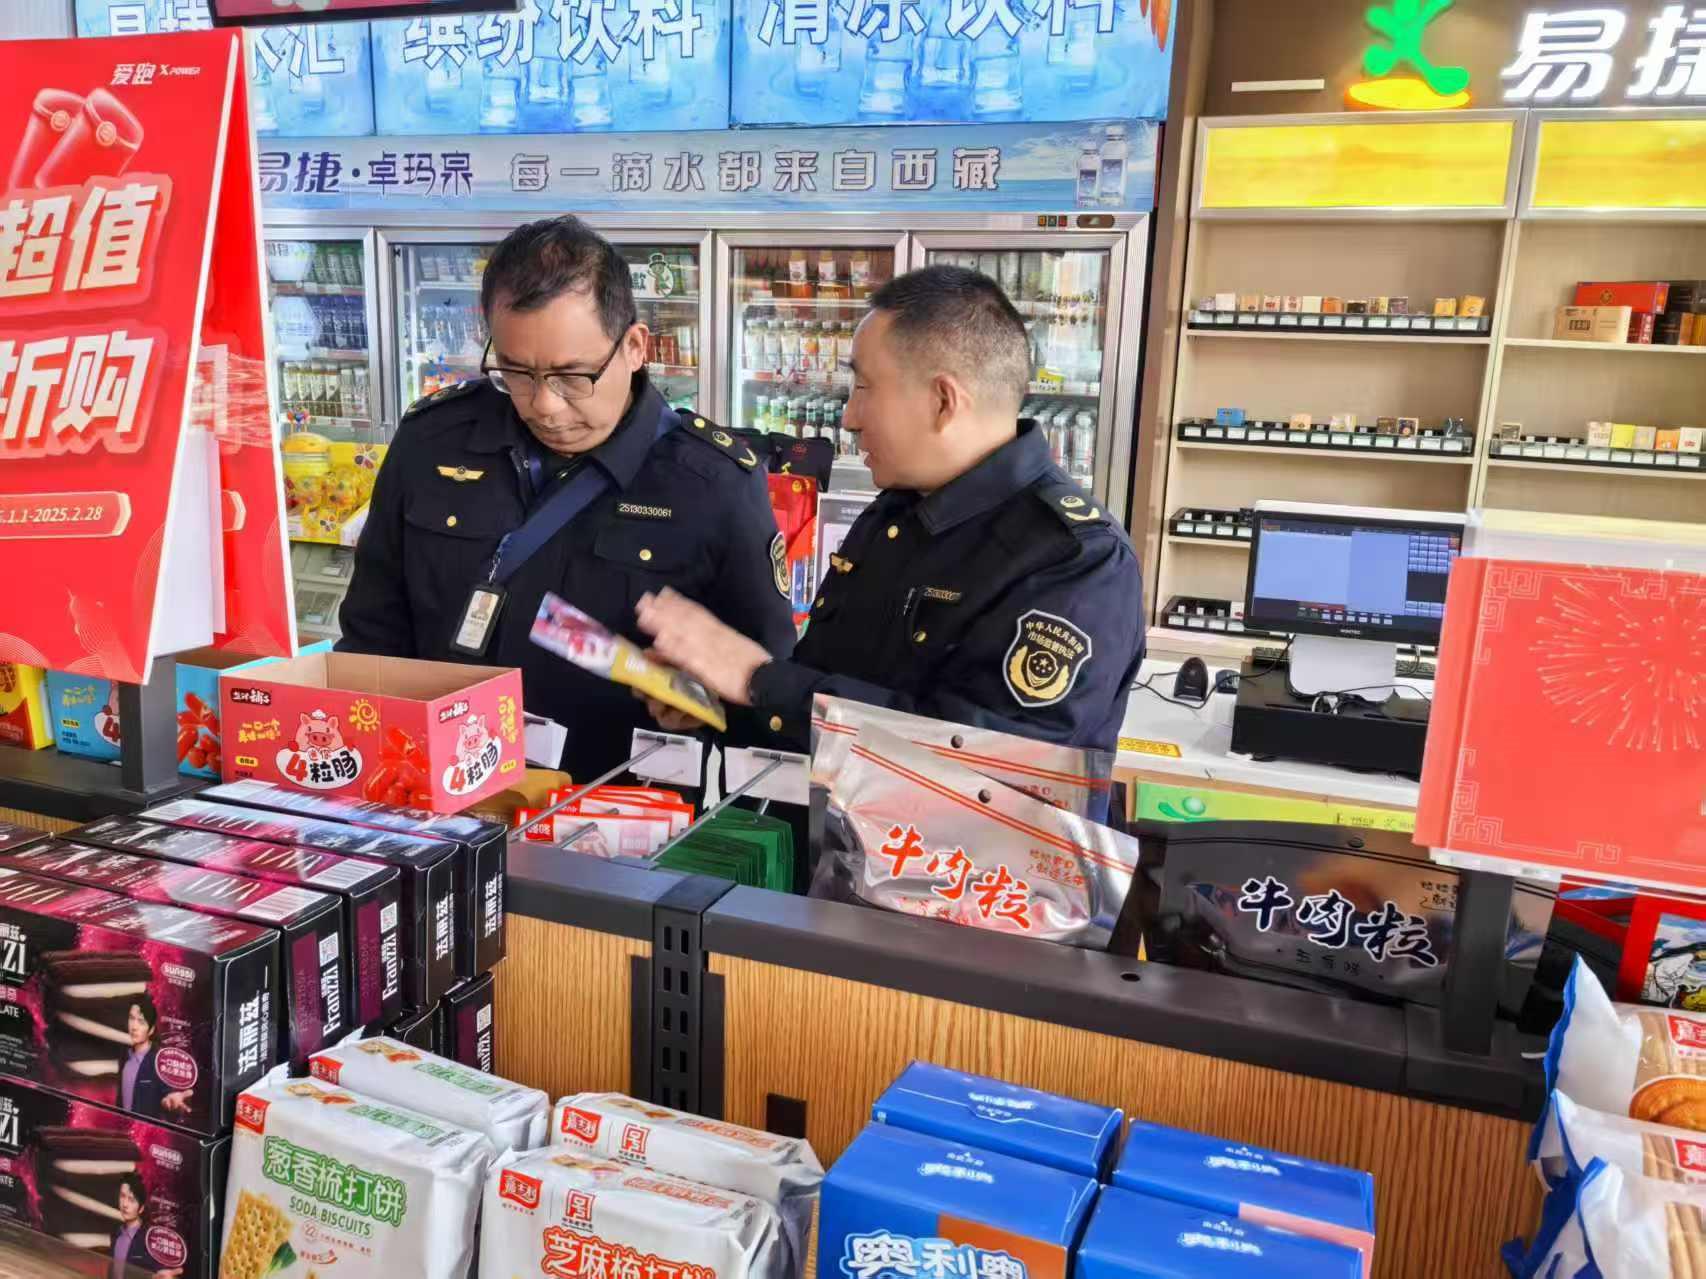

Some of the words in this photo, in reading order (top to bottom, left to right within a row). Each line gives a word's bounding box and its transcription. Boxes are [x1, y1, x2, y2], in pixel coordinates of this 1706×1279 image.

[110, 62, 157, 86] 爱跑
[511, 147, 1001, 193] 每一滴水都来自西藏
[0, 183, 159, 298] 超值
[879, 824, 1031, 930] 牛肉粒
[1237, 876, 1438, 967] 牛肉粒
[264, 1137, 405, 1225] 葱香梳打饼
[288, 1195, 318, 1219] SODA
[320, 1207, 372, 1237] BISCUITS
